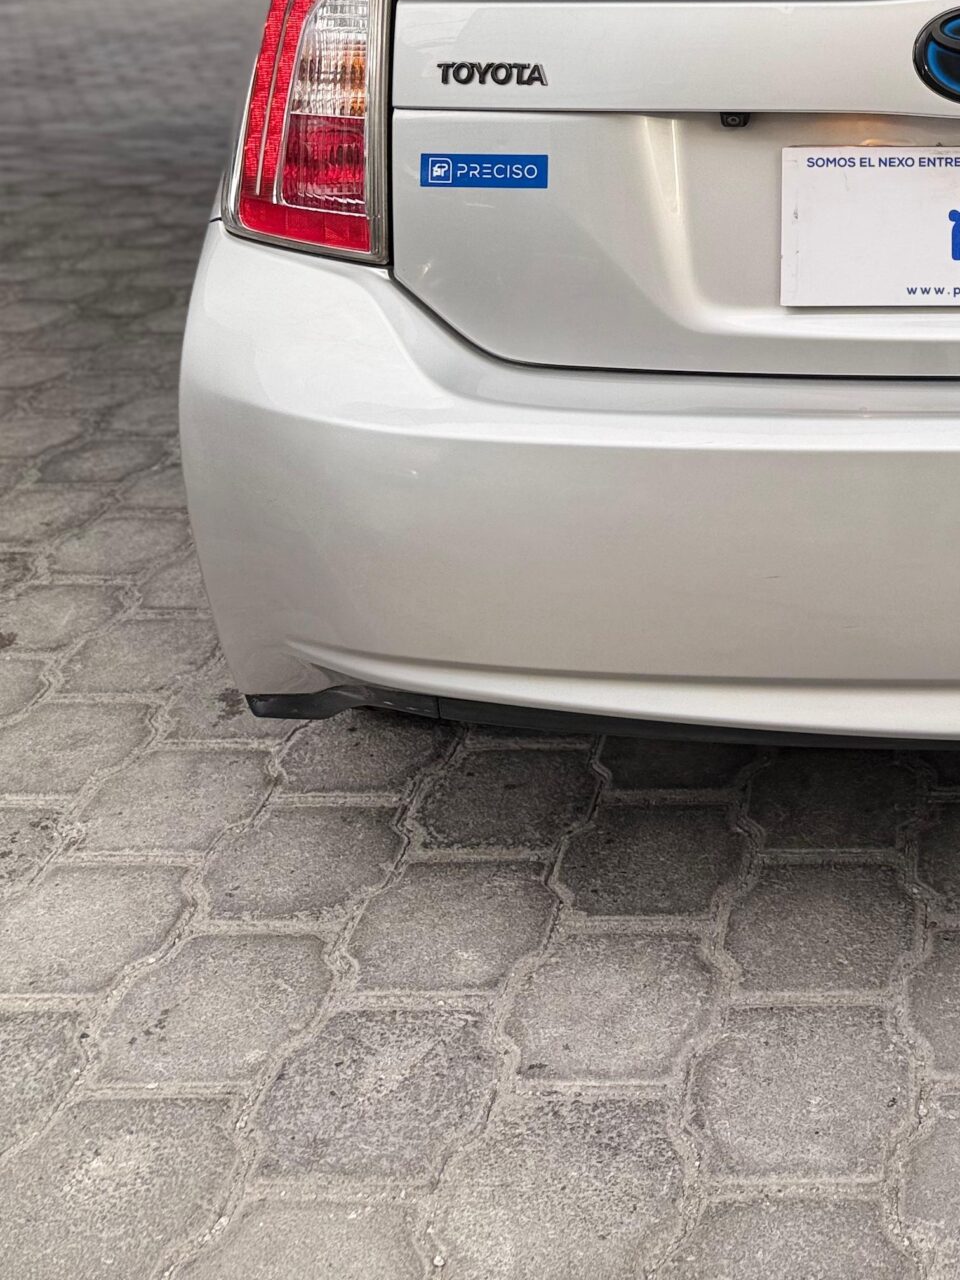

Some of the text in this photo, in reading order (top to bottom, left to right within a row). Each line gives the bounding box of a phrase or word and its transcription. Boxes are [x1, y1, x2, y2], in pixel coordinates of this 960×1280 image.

[437, 62, 549, 86] TOYOTA
[806, 156, 856, 168] SOMOS
[859, 156, 876, 168] EL
[878, 156, 915, 168] NEXO
[457, 163, 538, 179] PRECISO
